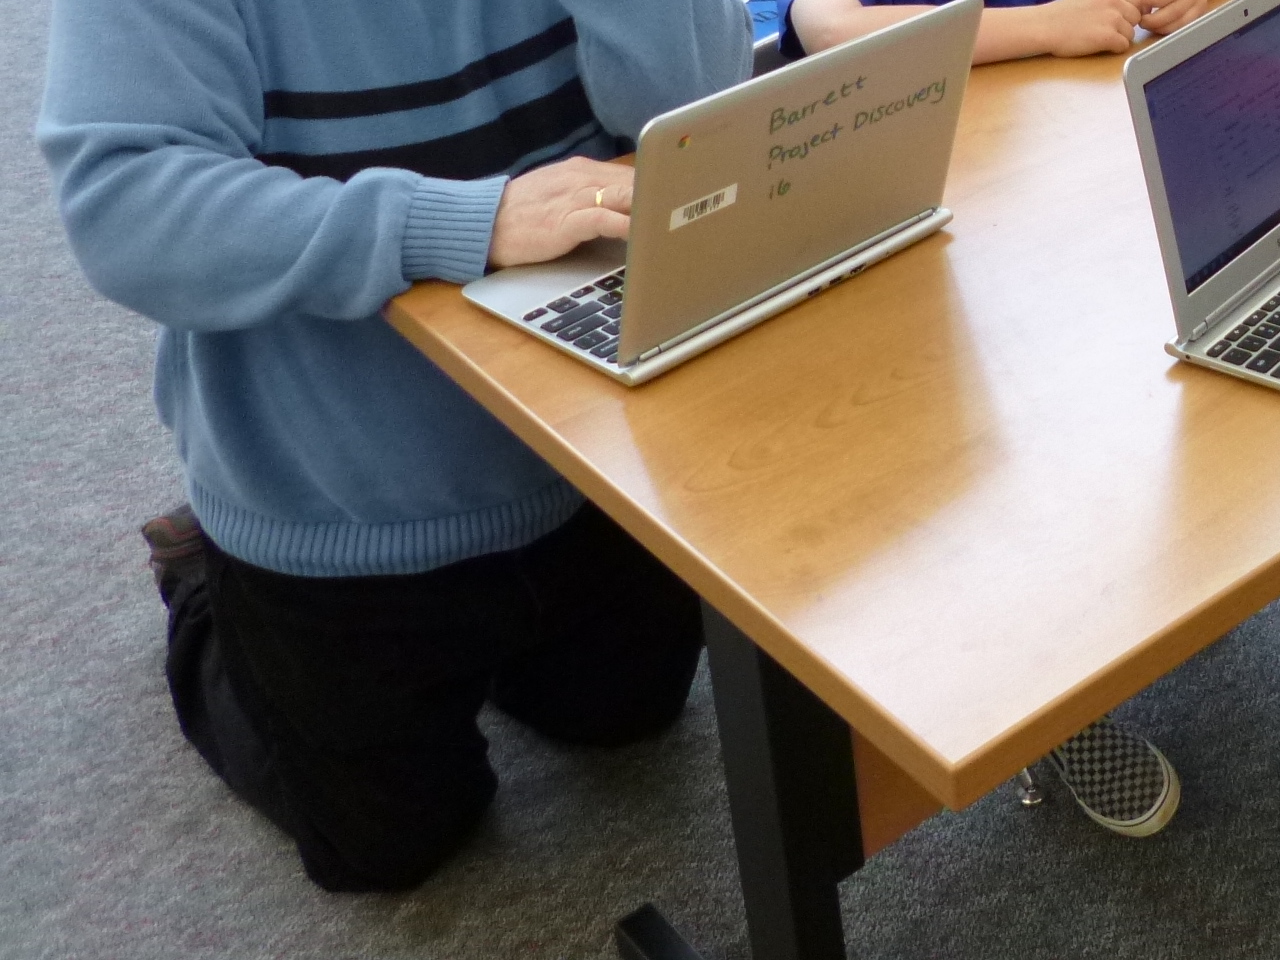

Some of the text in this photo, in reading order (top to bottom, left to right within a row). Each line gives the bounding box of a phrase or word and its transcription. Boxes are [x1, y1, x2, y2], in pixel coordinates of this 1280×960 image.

[767, 78, 948, 170] Project Discovery
[768, 75, 868, 135] Barrett
